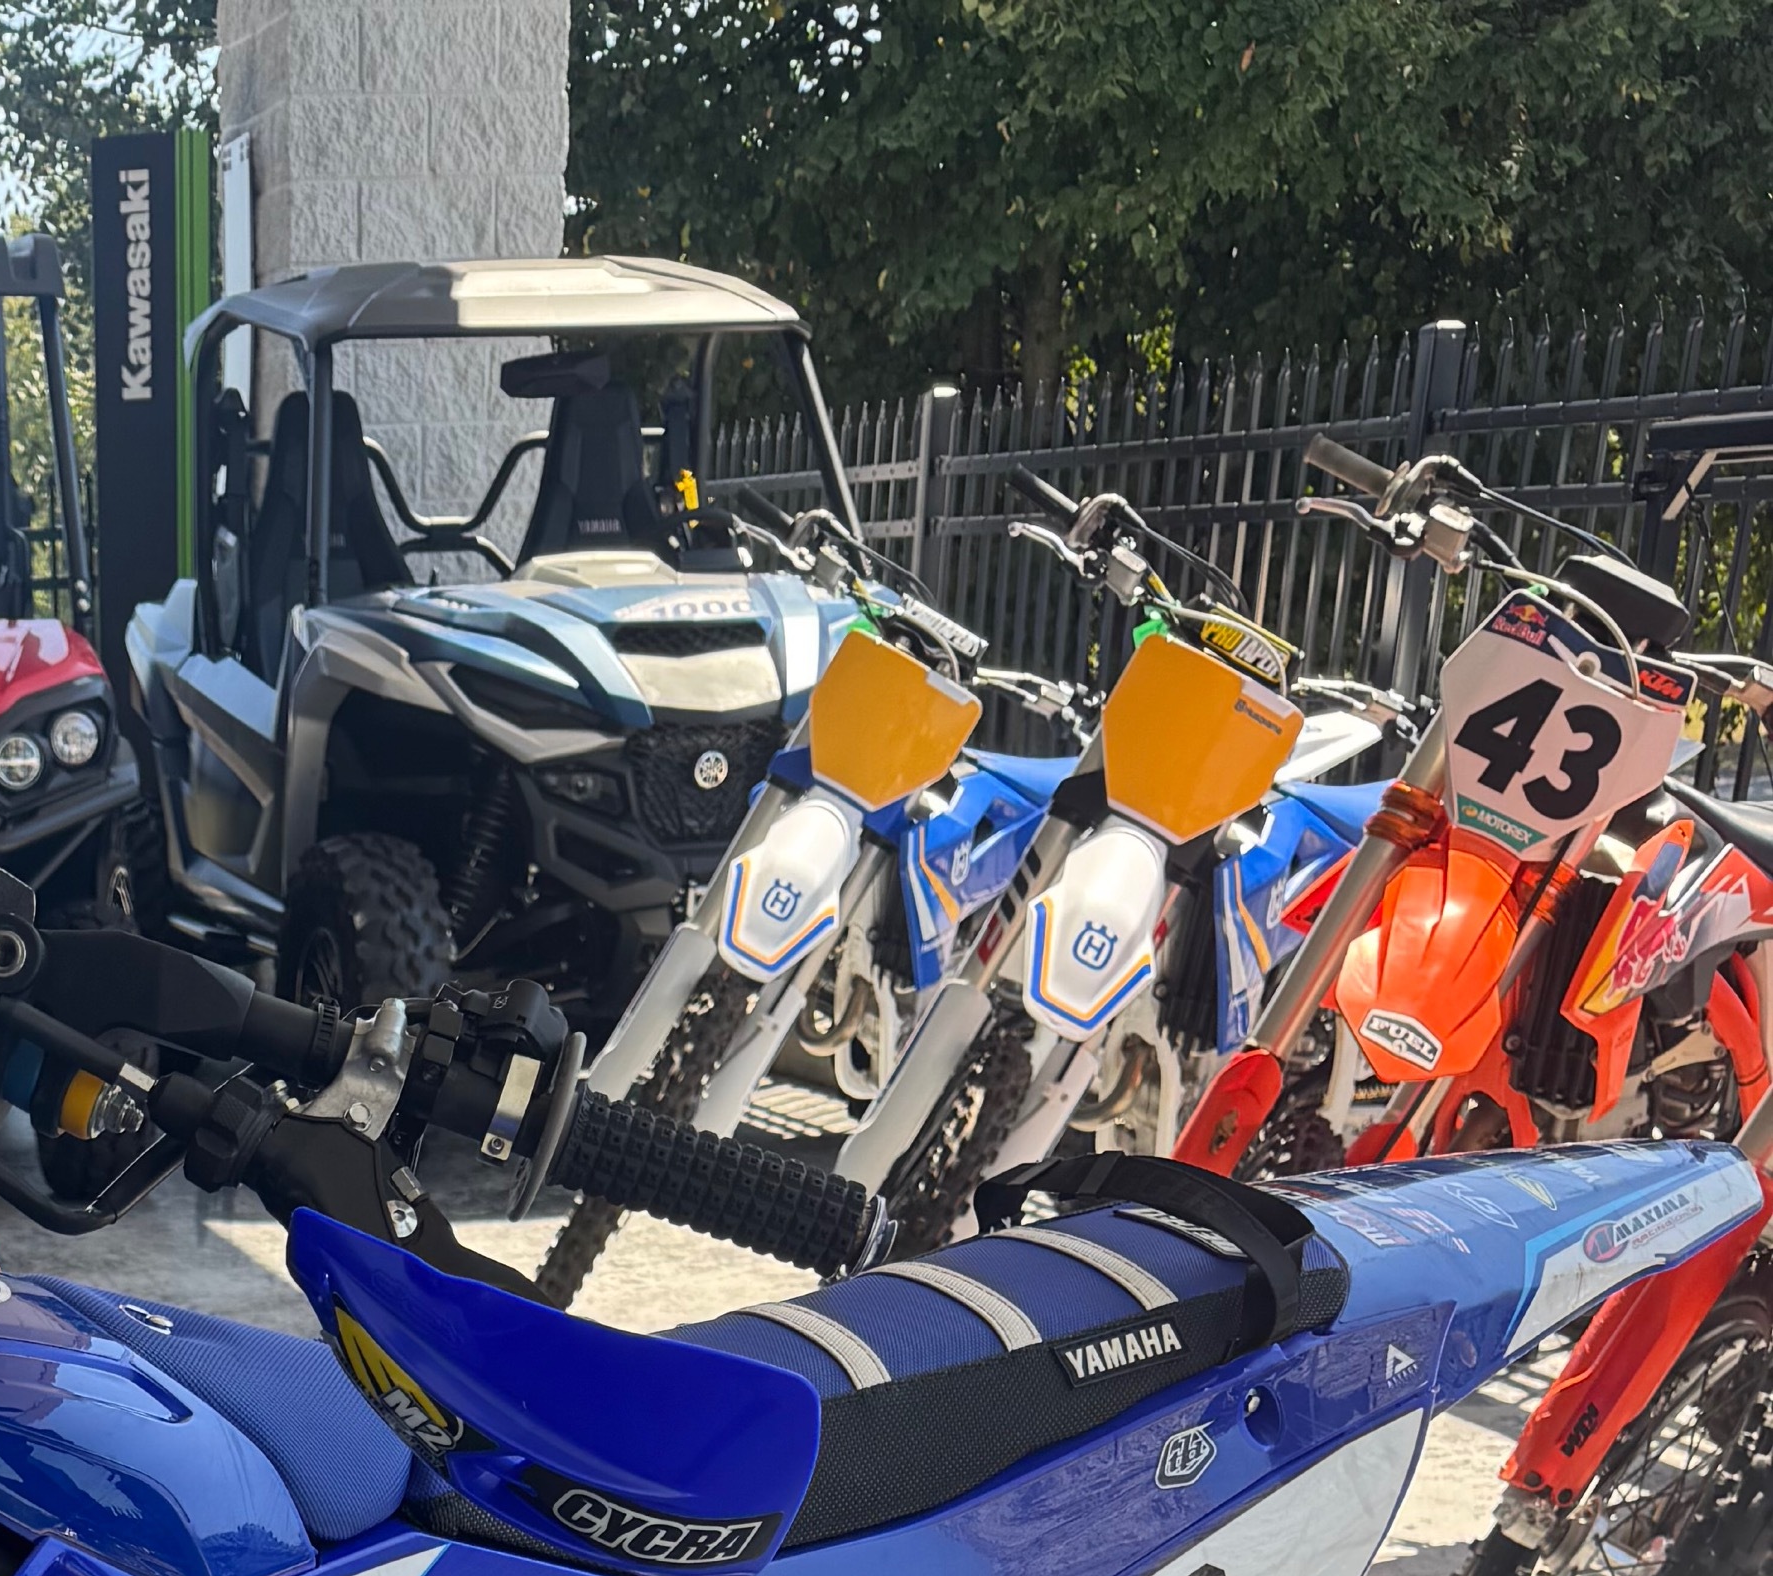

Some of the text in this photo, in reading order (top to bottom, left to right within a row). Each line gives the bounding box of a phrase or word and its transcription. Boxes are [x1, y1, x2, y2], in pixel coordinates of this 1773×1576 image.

[118, 168, 152, 400] Kawasaki
[577, 518, 622, 534] YAMAHA
[1639, 669, 1684, 699] KTM
[1454, 678, 1622, 820] 43
[1477, 807, 1533, 844] MOTOREX
[1368, 1016, 1434, 1060] FUEL
[1613, 1193, 1691, 1244] MAXIMA
[1065, 1323, 1182, 1379] YAMAHA
[382, 1387, 457, 1455] M2
[553, 1488, 763, 1564] CYCRA
